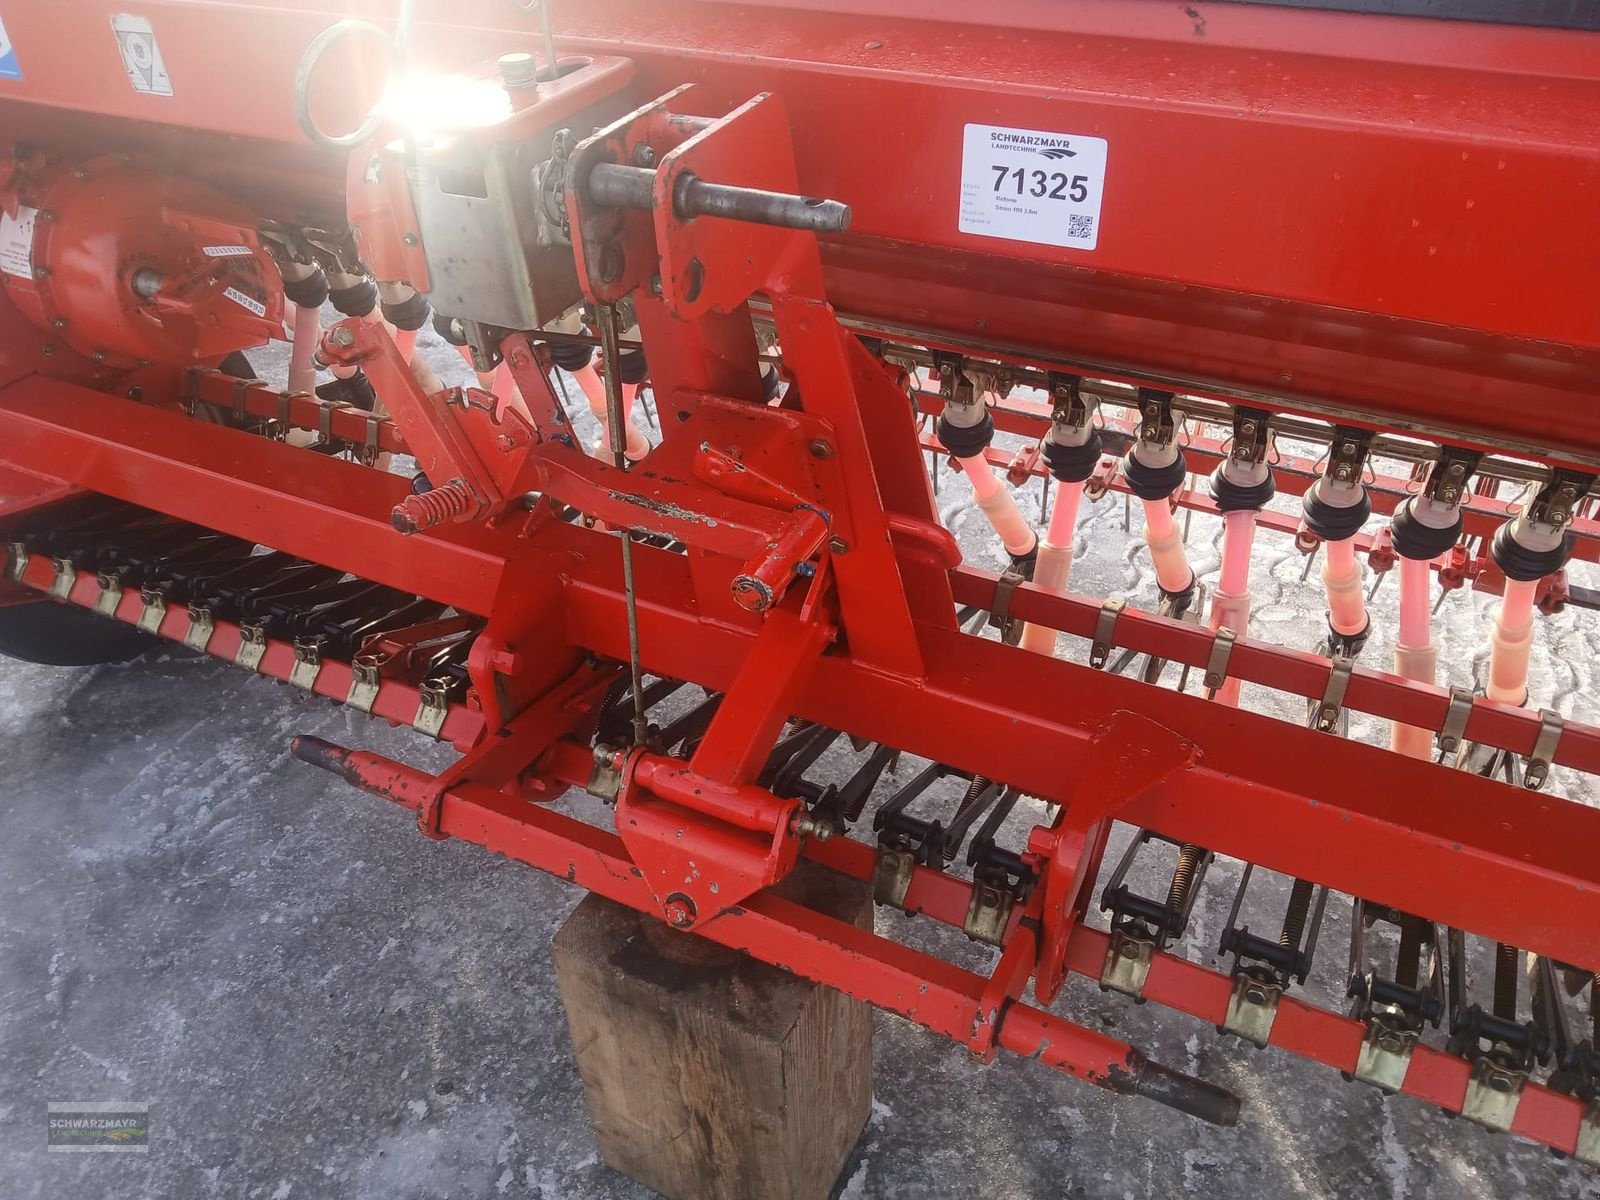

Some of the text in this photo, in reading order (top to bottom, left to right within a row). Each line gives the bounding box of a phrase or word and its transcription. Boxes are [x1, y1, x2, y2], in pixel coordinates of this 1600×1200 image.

[990, 132, 1070, 149] SCHWARZMAYR
[991, 143, 1037, 153] LANDTECHNIK
[991, 165, 1089, 203] 71325
